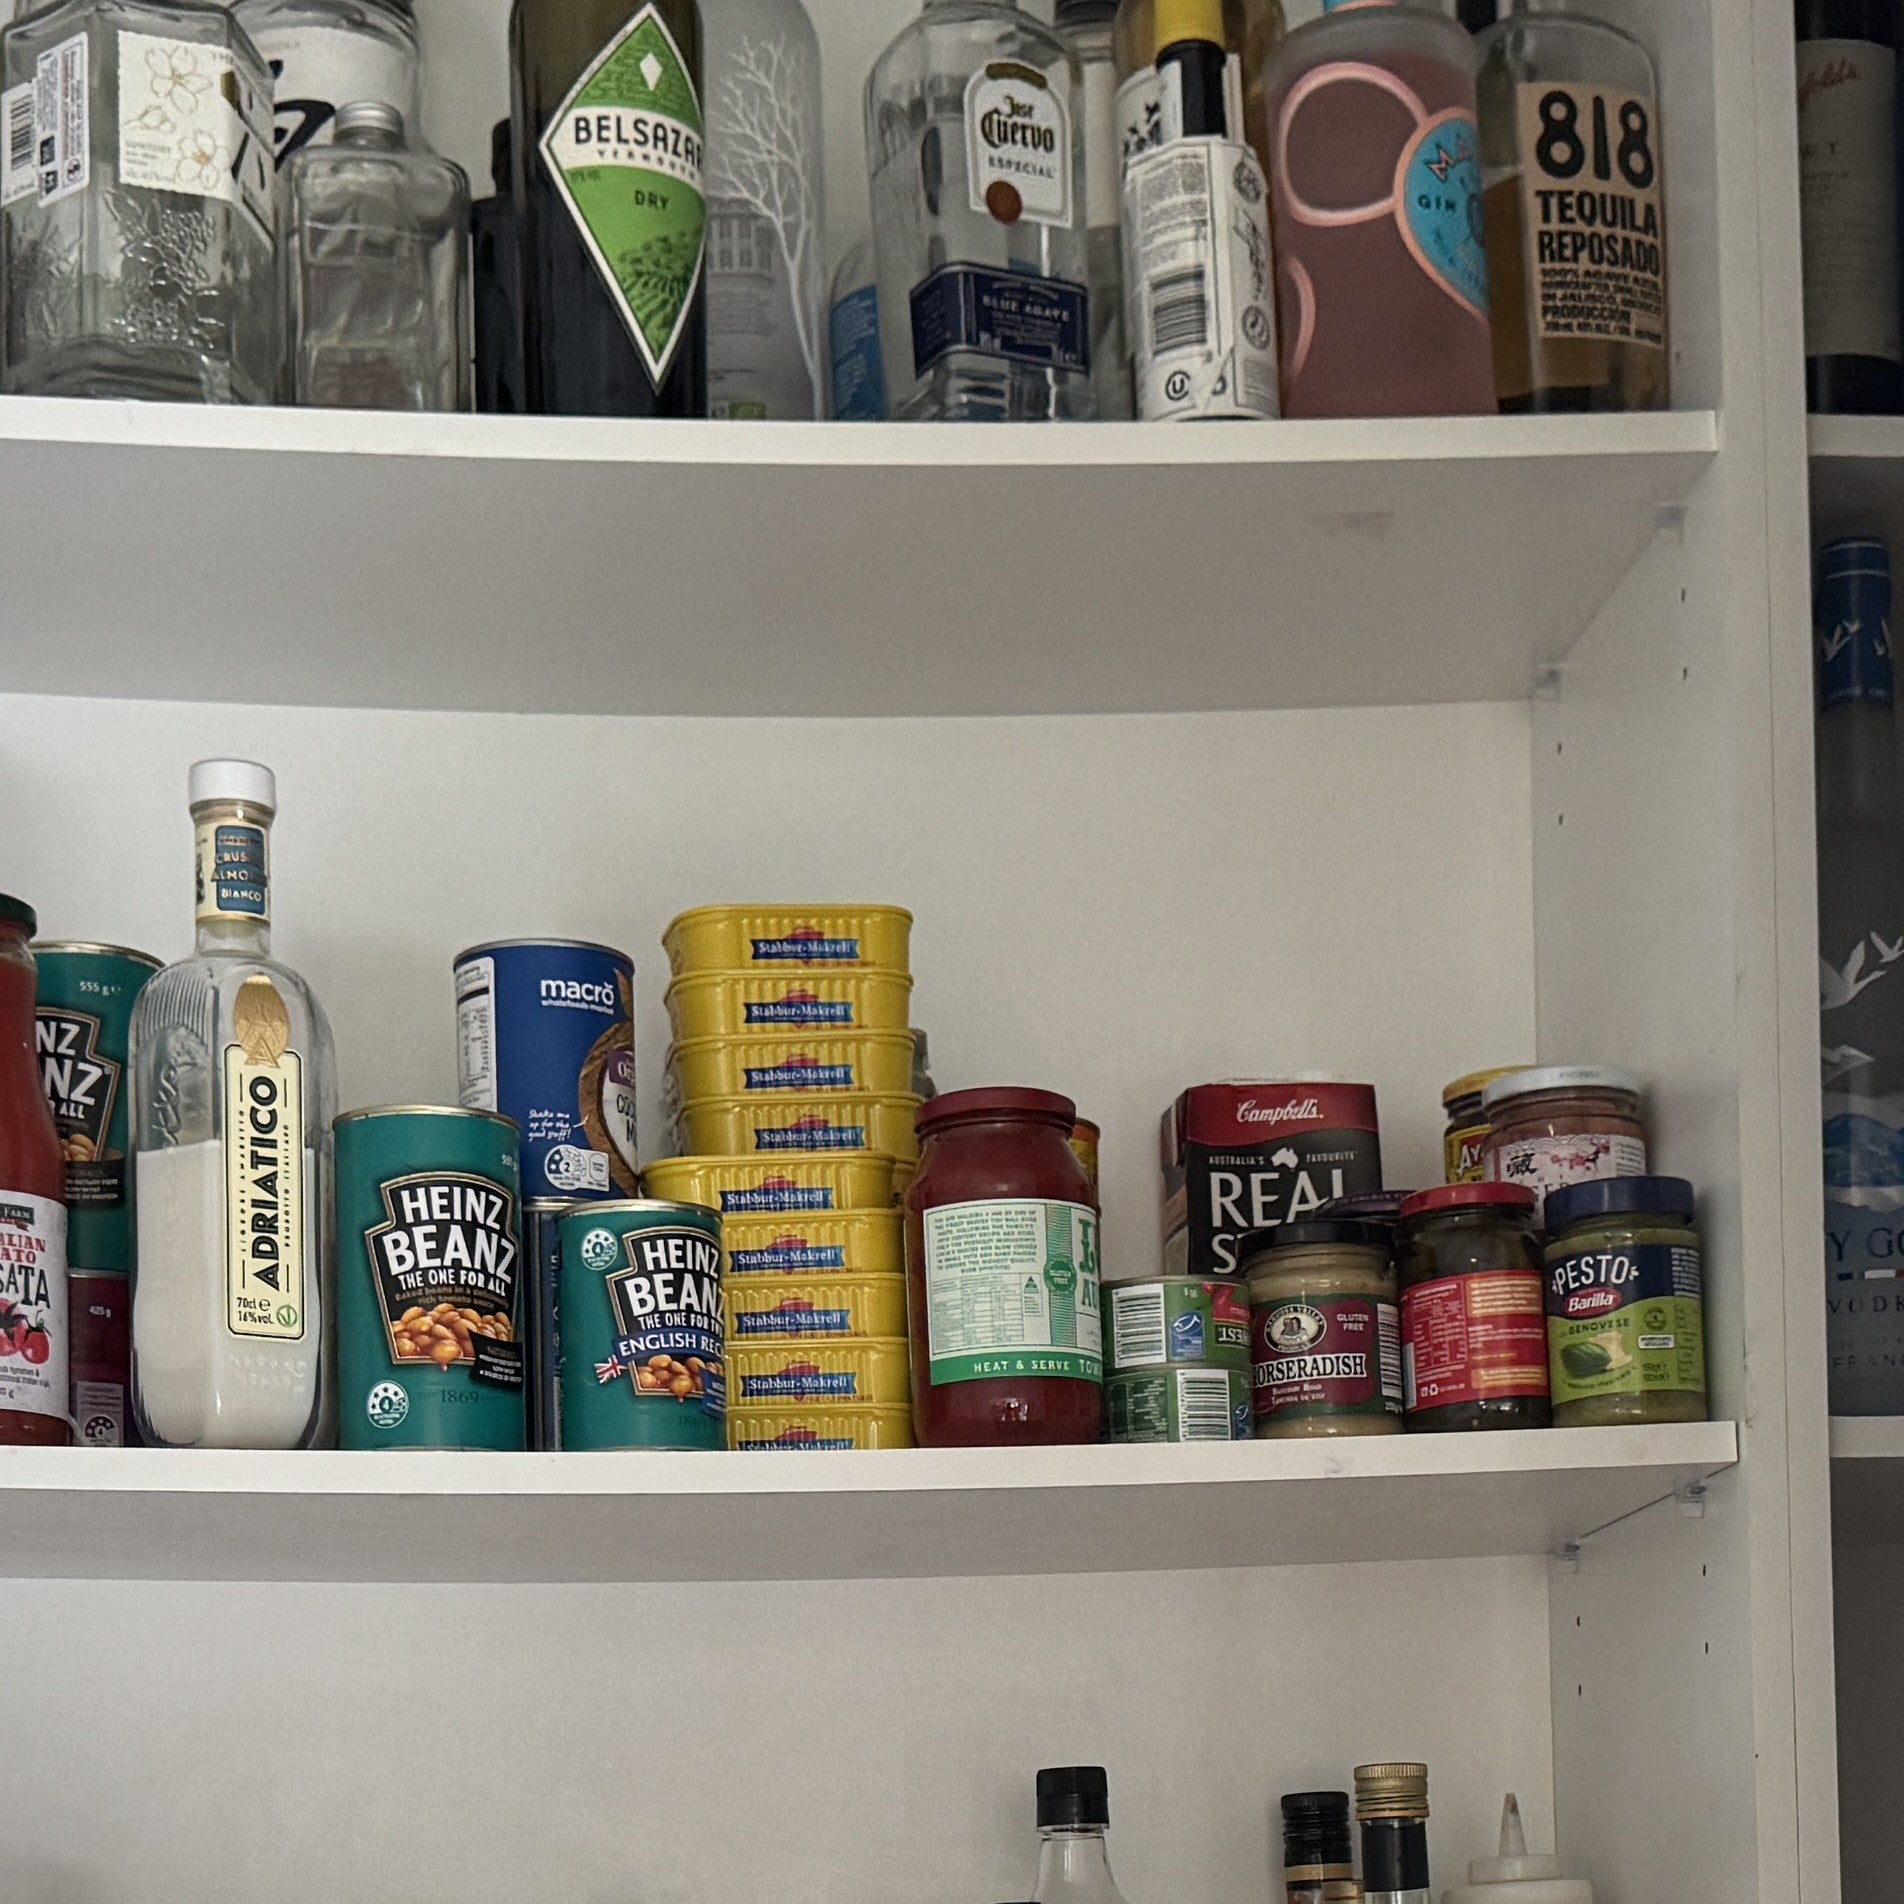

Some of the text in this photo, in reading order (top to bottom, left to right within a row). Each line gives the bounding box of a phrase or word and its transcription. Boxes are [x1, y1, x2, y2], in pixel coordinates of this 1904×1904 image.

[981, 108, 1055, 153] Cuervo
[1536, 90, 1654, 189] 818
[987, 157, 1056, 180] ESPECIAL
[634, 190, 669, 211] DRY
[1535, 190, 1658, 240] TEQUILA
[1538, 231, 1661, 277] REPOSADO
[80, 981, 99, 993] 555
[59, 1104, 85, 1119] ALL
[563, 1162, 570, 1172] 2
[1209, 1151, 1355, 1166] AUSTRALIA'S FAVOURITE
[249, 1075, 282, 1292] ADRIATICO
[727, 1189, 824, 1206] Stabbur-Makrell
[401, 1186, 502, 1230] HEINZ
[383, 1225, 515, 1284] BEANZ
[642, 1239, 719, 1279] HEINZ
[737, 1248, 836, 1266] Stabbur-Makrell
[398, 1269, 505, 1297] THE ONE FOR ALL
[1556, 1255, 1628, 1294] PESTO
[236, 1295, 257, 1311] 70cl
[1568, 1293, 1615, 1312] Barilla
[638, 1312, 709, 1330] THE ONE FOR
[743, 1312, 841, 1328] Stabbur-Makrell
[1336, 1313, 1369, 1323] GLUTEN
[1343, 1322, 1364, 1331] FREE
[1569, 1318, 1631, 1335] GENOVESE
[618, 1332, 697, 1357] ENGLISH
[973, 1359, 1070, 1373] HEAT & SERVE
[749, 1375, 848, 1391] Stabbur-Makrell
[441, 1389, 479, 1403] 1869
